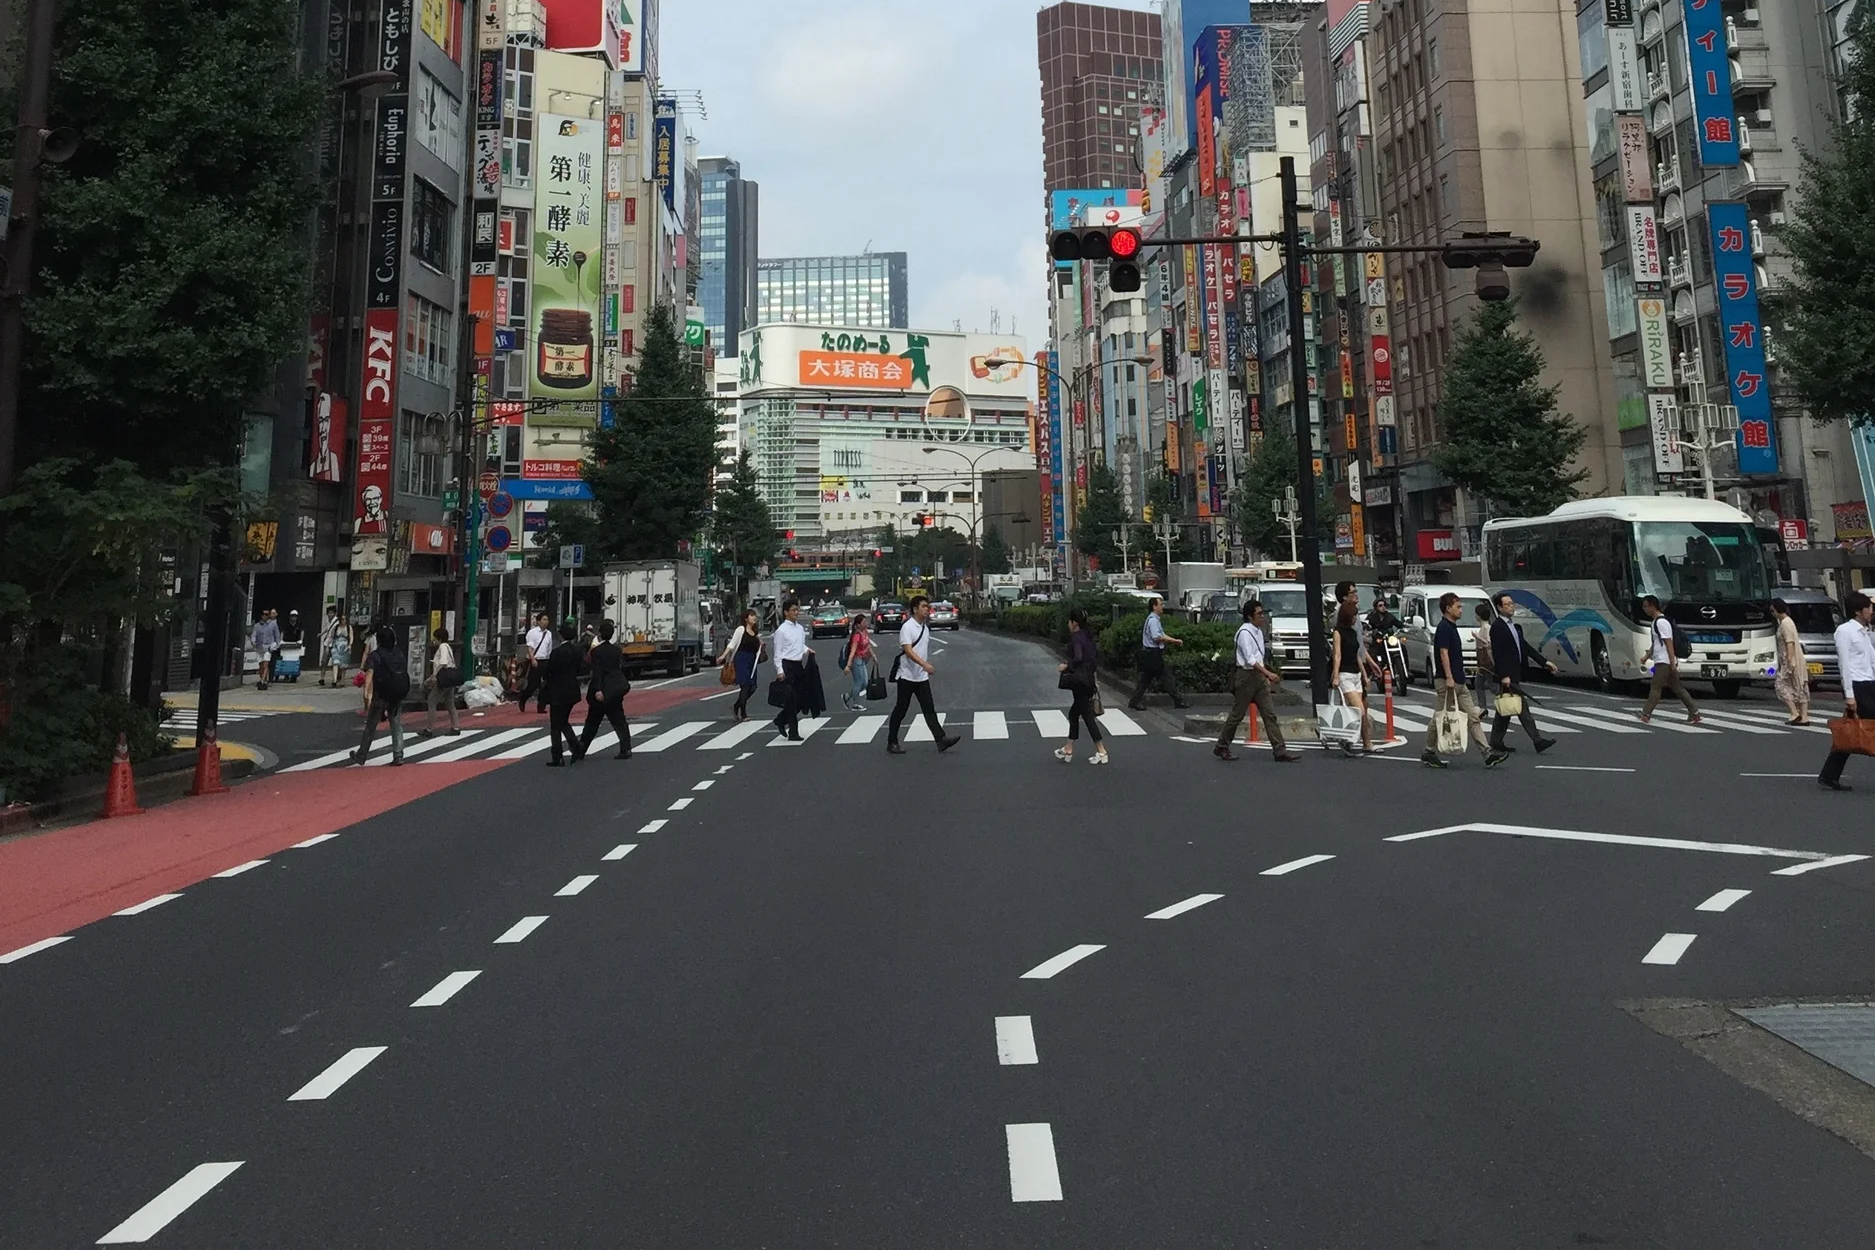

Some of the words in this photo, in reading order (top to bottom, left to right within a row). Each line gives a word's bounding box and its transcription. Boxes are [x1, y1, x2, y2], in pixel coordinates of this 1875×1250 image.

[383, 8, 400, 71] ともしび
[485, 37, 499, 45] 5F
[1216, 29, 1231, 97] PROMISE
[481, 62, 493, 106] カラオケ
[384, 108, 404, 164] Euphoria
[382, 184, 396, 196] 5F
[546, 155, 573, 268] 第一酵素
[478, 214, 493, 242] 和民
[1634, 212, 1645, 252] BRAND
[375, 208, 398, 283] Convivio
[475, 263, 492, 274] 2F
[1639, 253, 1648, 276] OFF
[376, 293, 391, 303] 4F
[821, 331, 891, 354] たのめーる
[1718, 226, 1771, 447] カラオケ館
[366, 326, 393, 405] KFC
[808, 359, 903, 380] 大塚商会
[1194, 392, 1203, 415] レイク
[371, 426, 383, 434] 3F
[1655, 400, 1666, 441] BRAND
[369, 454, 381, 462] 2F
[525, 462, 561, 472] トルコ料理
